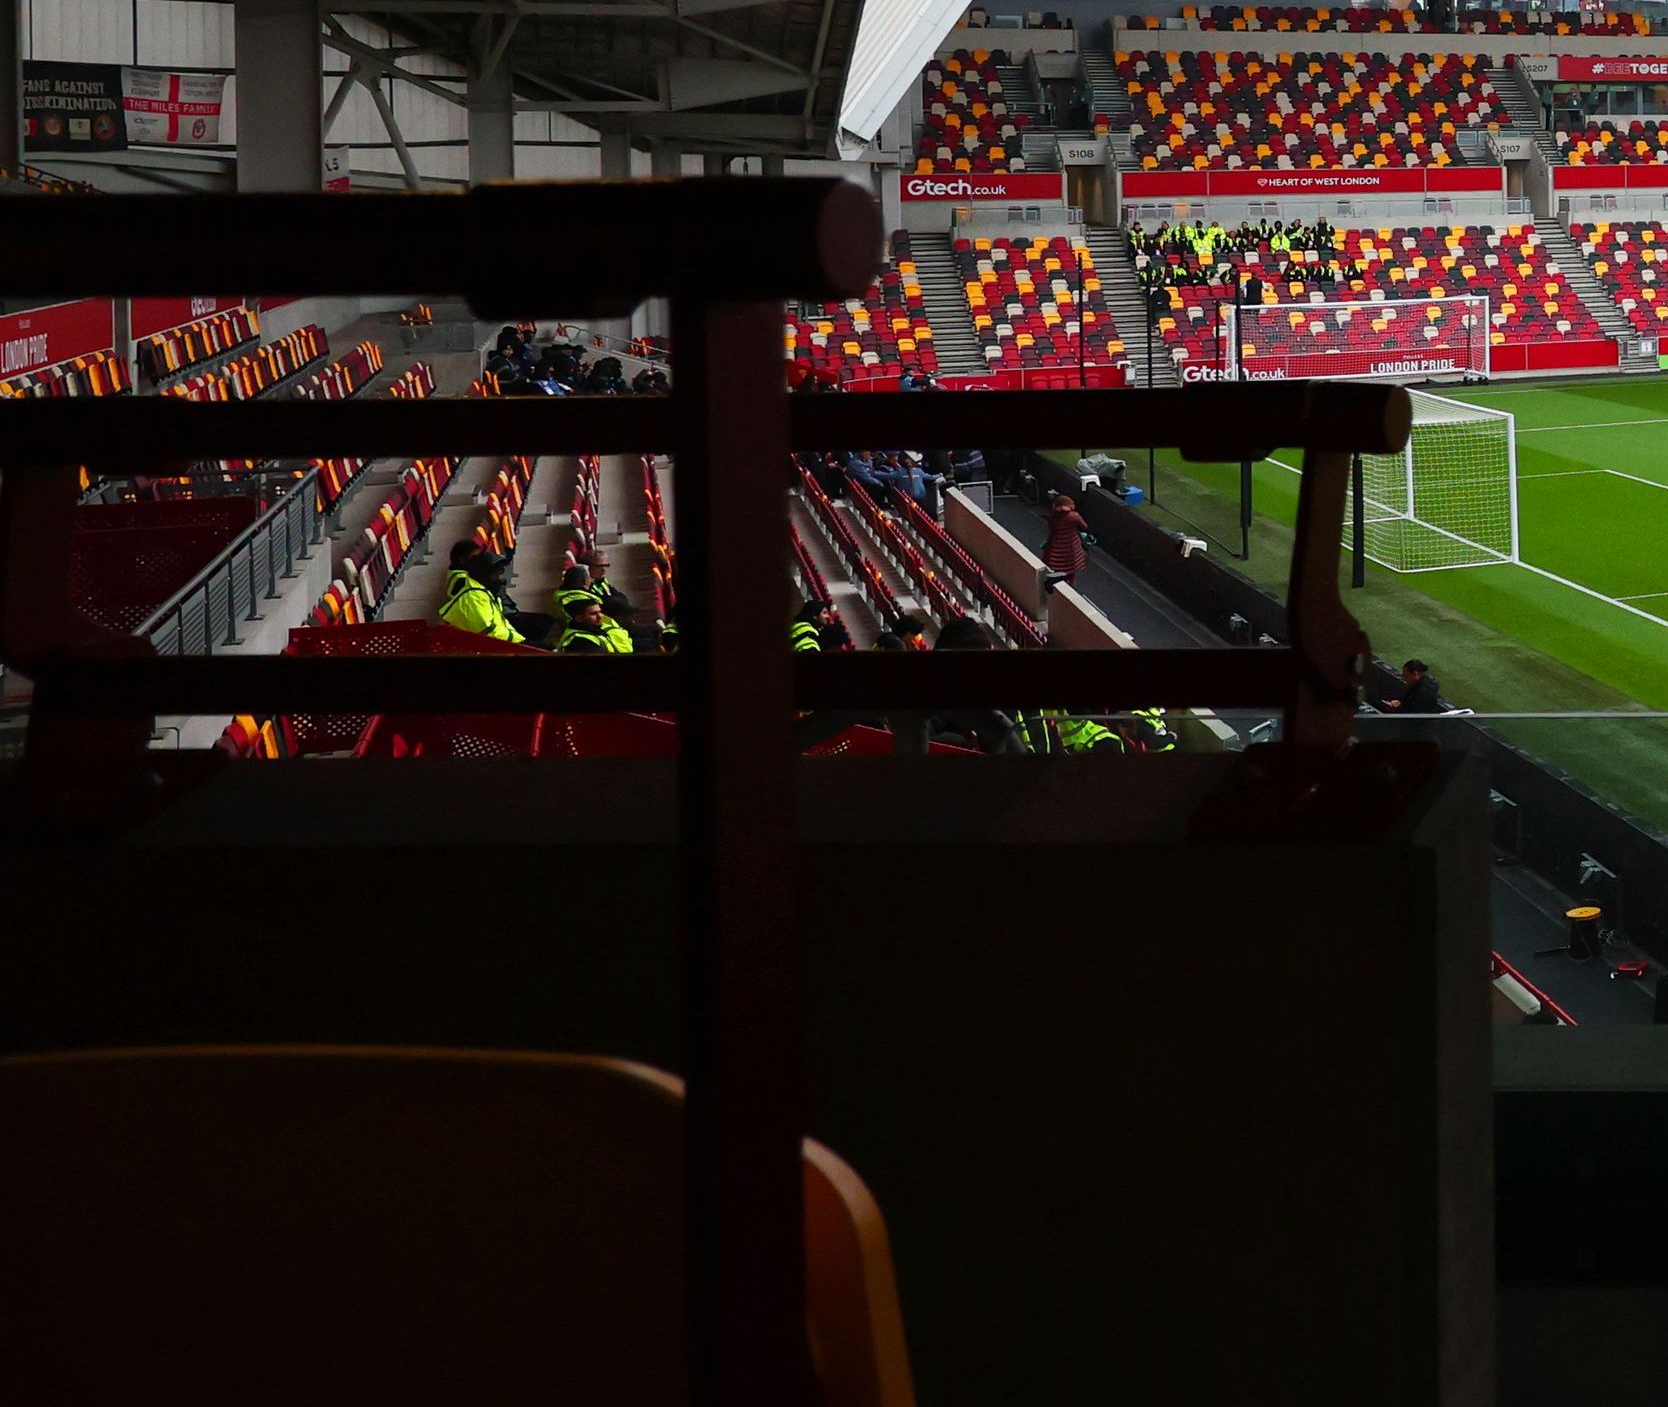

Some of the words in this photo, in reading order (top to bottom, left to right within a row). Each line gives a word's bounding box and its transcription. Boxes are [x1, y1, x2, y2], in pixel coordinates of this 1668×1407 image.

[24, 79, 50, 92] FANS
[54, 80, 104, 95] AGAINST
[24, 96, 117, 111] ISCRIMINATION
[128, 99, 148, 110] THE
[151, 101, 180, 113] MILES
[1068, 149, 1095, 159] S108
[1501, 144, 1521, 154] S107
[907, 178, 1006, 196] Gtech.co.uk
[1268, 178, 1299, 187] HEART
[1300, 177, 1314, 186] OF
[1314, 177, 1340, 186] WEST
[1341, 176, 1380, 185] LONDON
[1, 340, 29, 373] LONDON
[29, 333, 48, 366] PRIDE
[1371, 361, 1419, 373] LONDON
[1421, 359, 1455, 370] PRIDE
